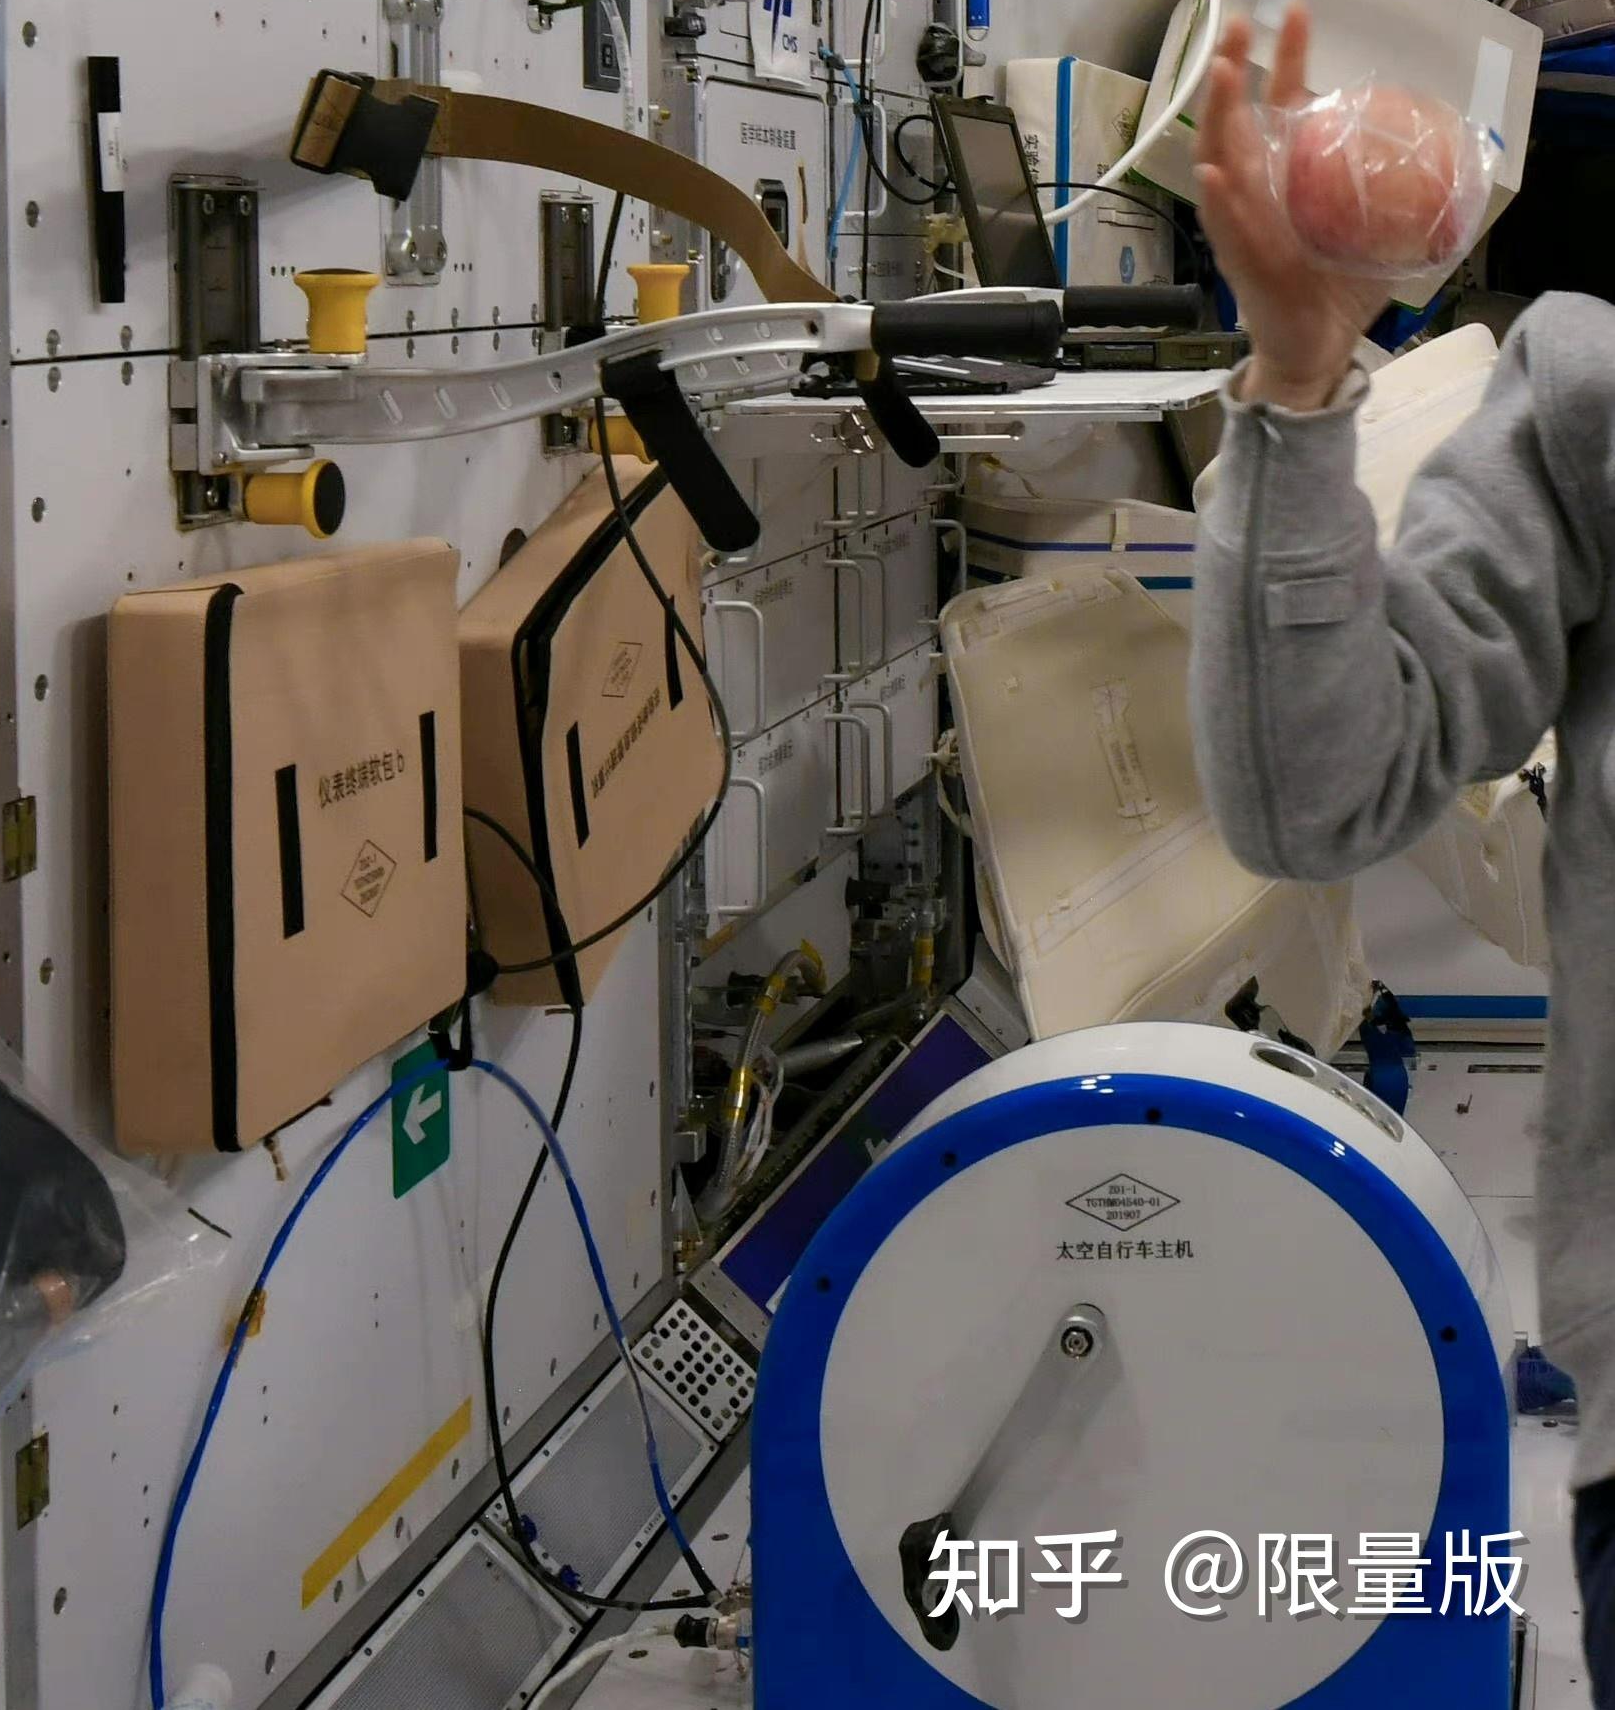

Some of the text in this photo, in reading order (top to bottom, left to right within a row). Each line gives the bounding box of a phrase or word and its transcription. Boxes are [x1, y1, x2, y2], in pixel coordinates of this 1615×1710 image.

[1105, 1209, 1142, 1221] 201907
[1055, 1238, 1195, 1261] 太空自行车主机
